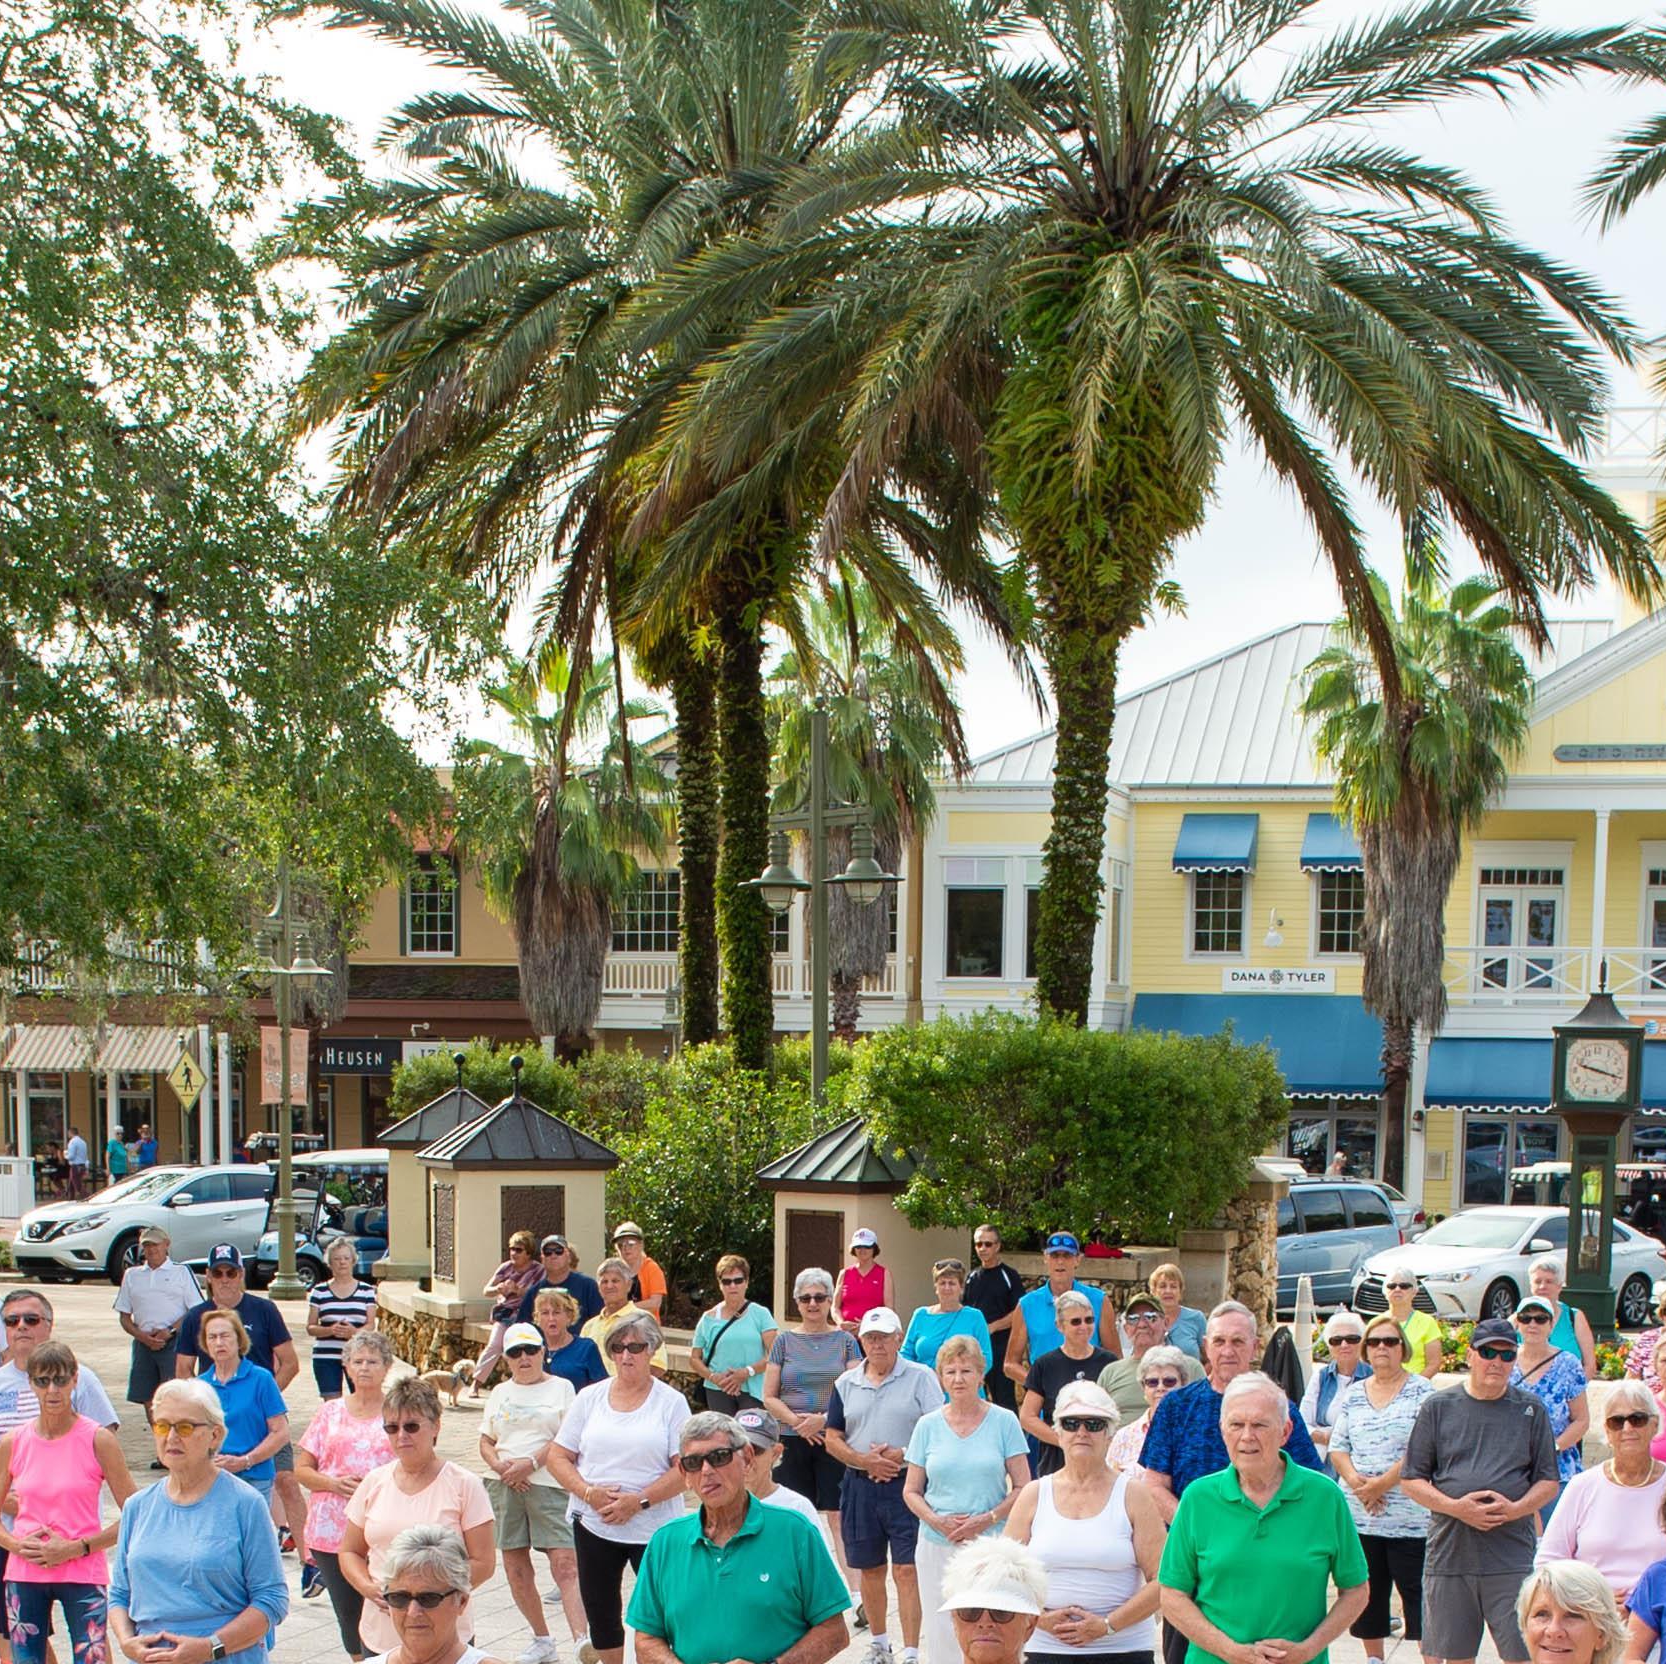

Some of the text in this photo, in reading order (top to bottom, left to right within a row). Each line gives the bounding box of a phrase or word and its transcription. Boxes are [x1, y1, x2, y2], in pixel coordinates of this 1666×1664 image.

[1231, 972, 1326, 982] DANA TYLER
[326, 1047, 383, 1066] HEUSEN
